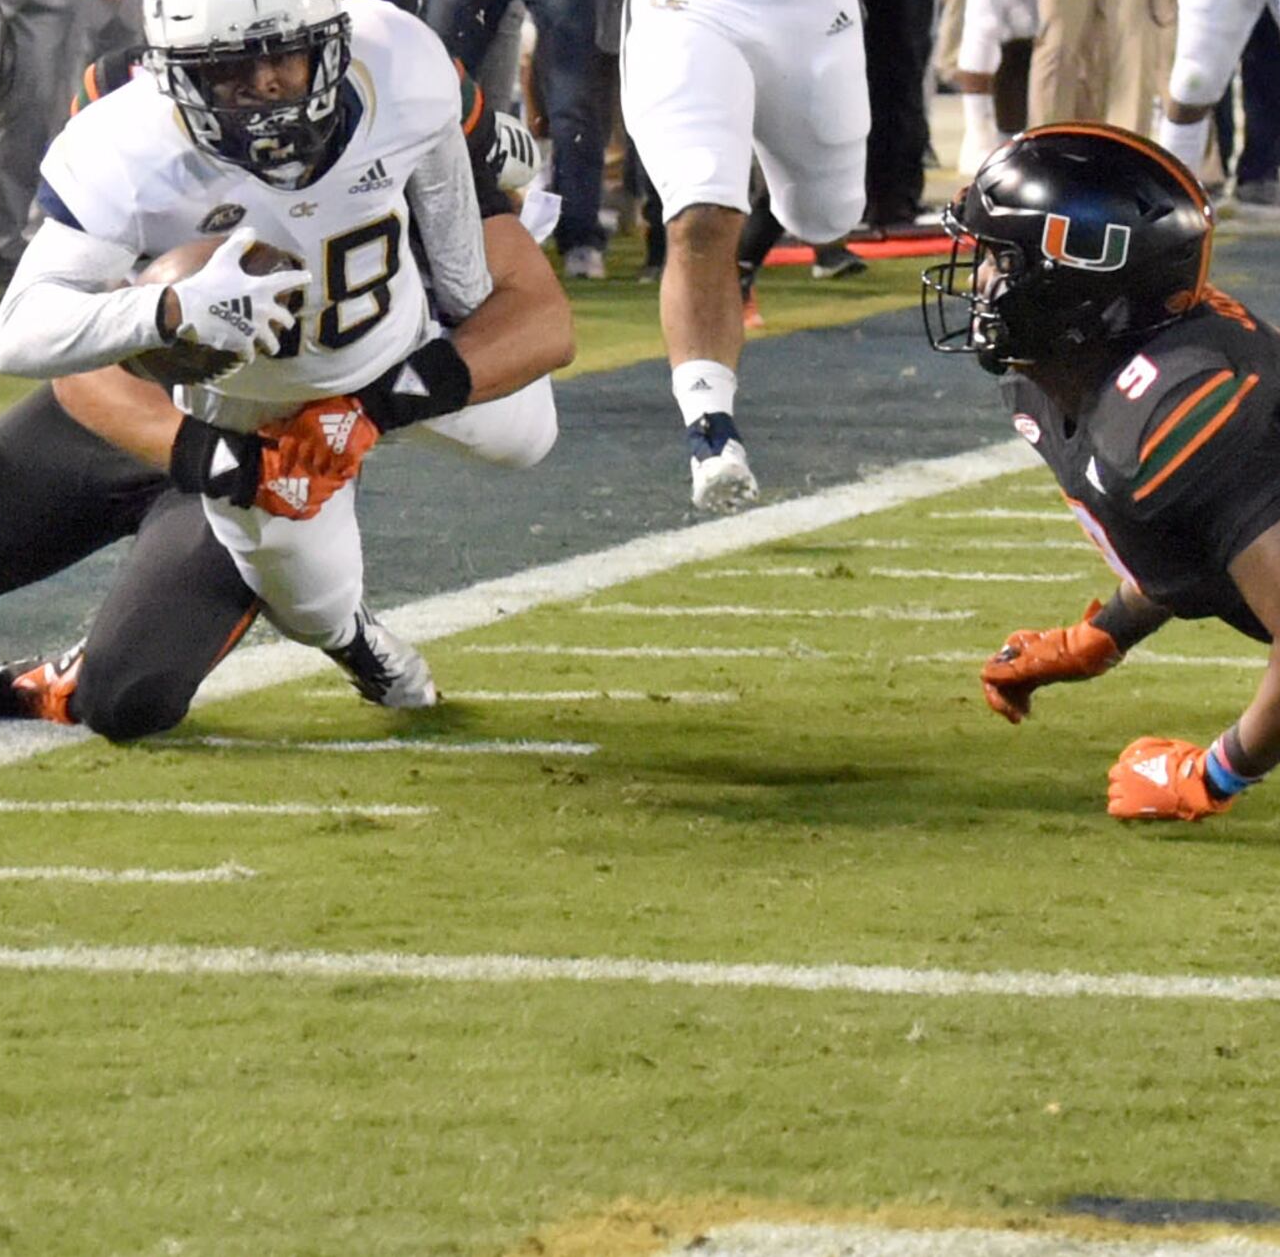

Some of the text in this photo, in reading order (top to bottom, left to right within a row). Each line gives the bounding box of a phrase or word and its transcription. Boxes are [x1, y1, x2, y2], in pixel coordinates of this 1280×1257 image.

[348, 176, 394, 195] adidas
[1041, 212, 1131, 273] U
[207, 303, 256, 337] adidas
